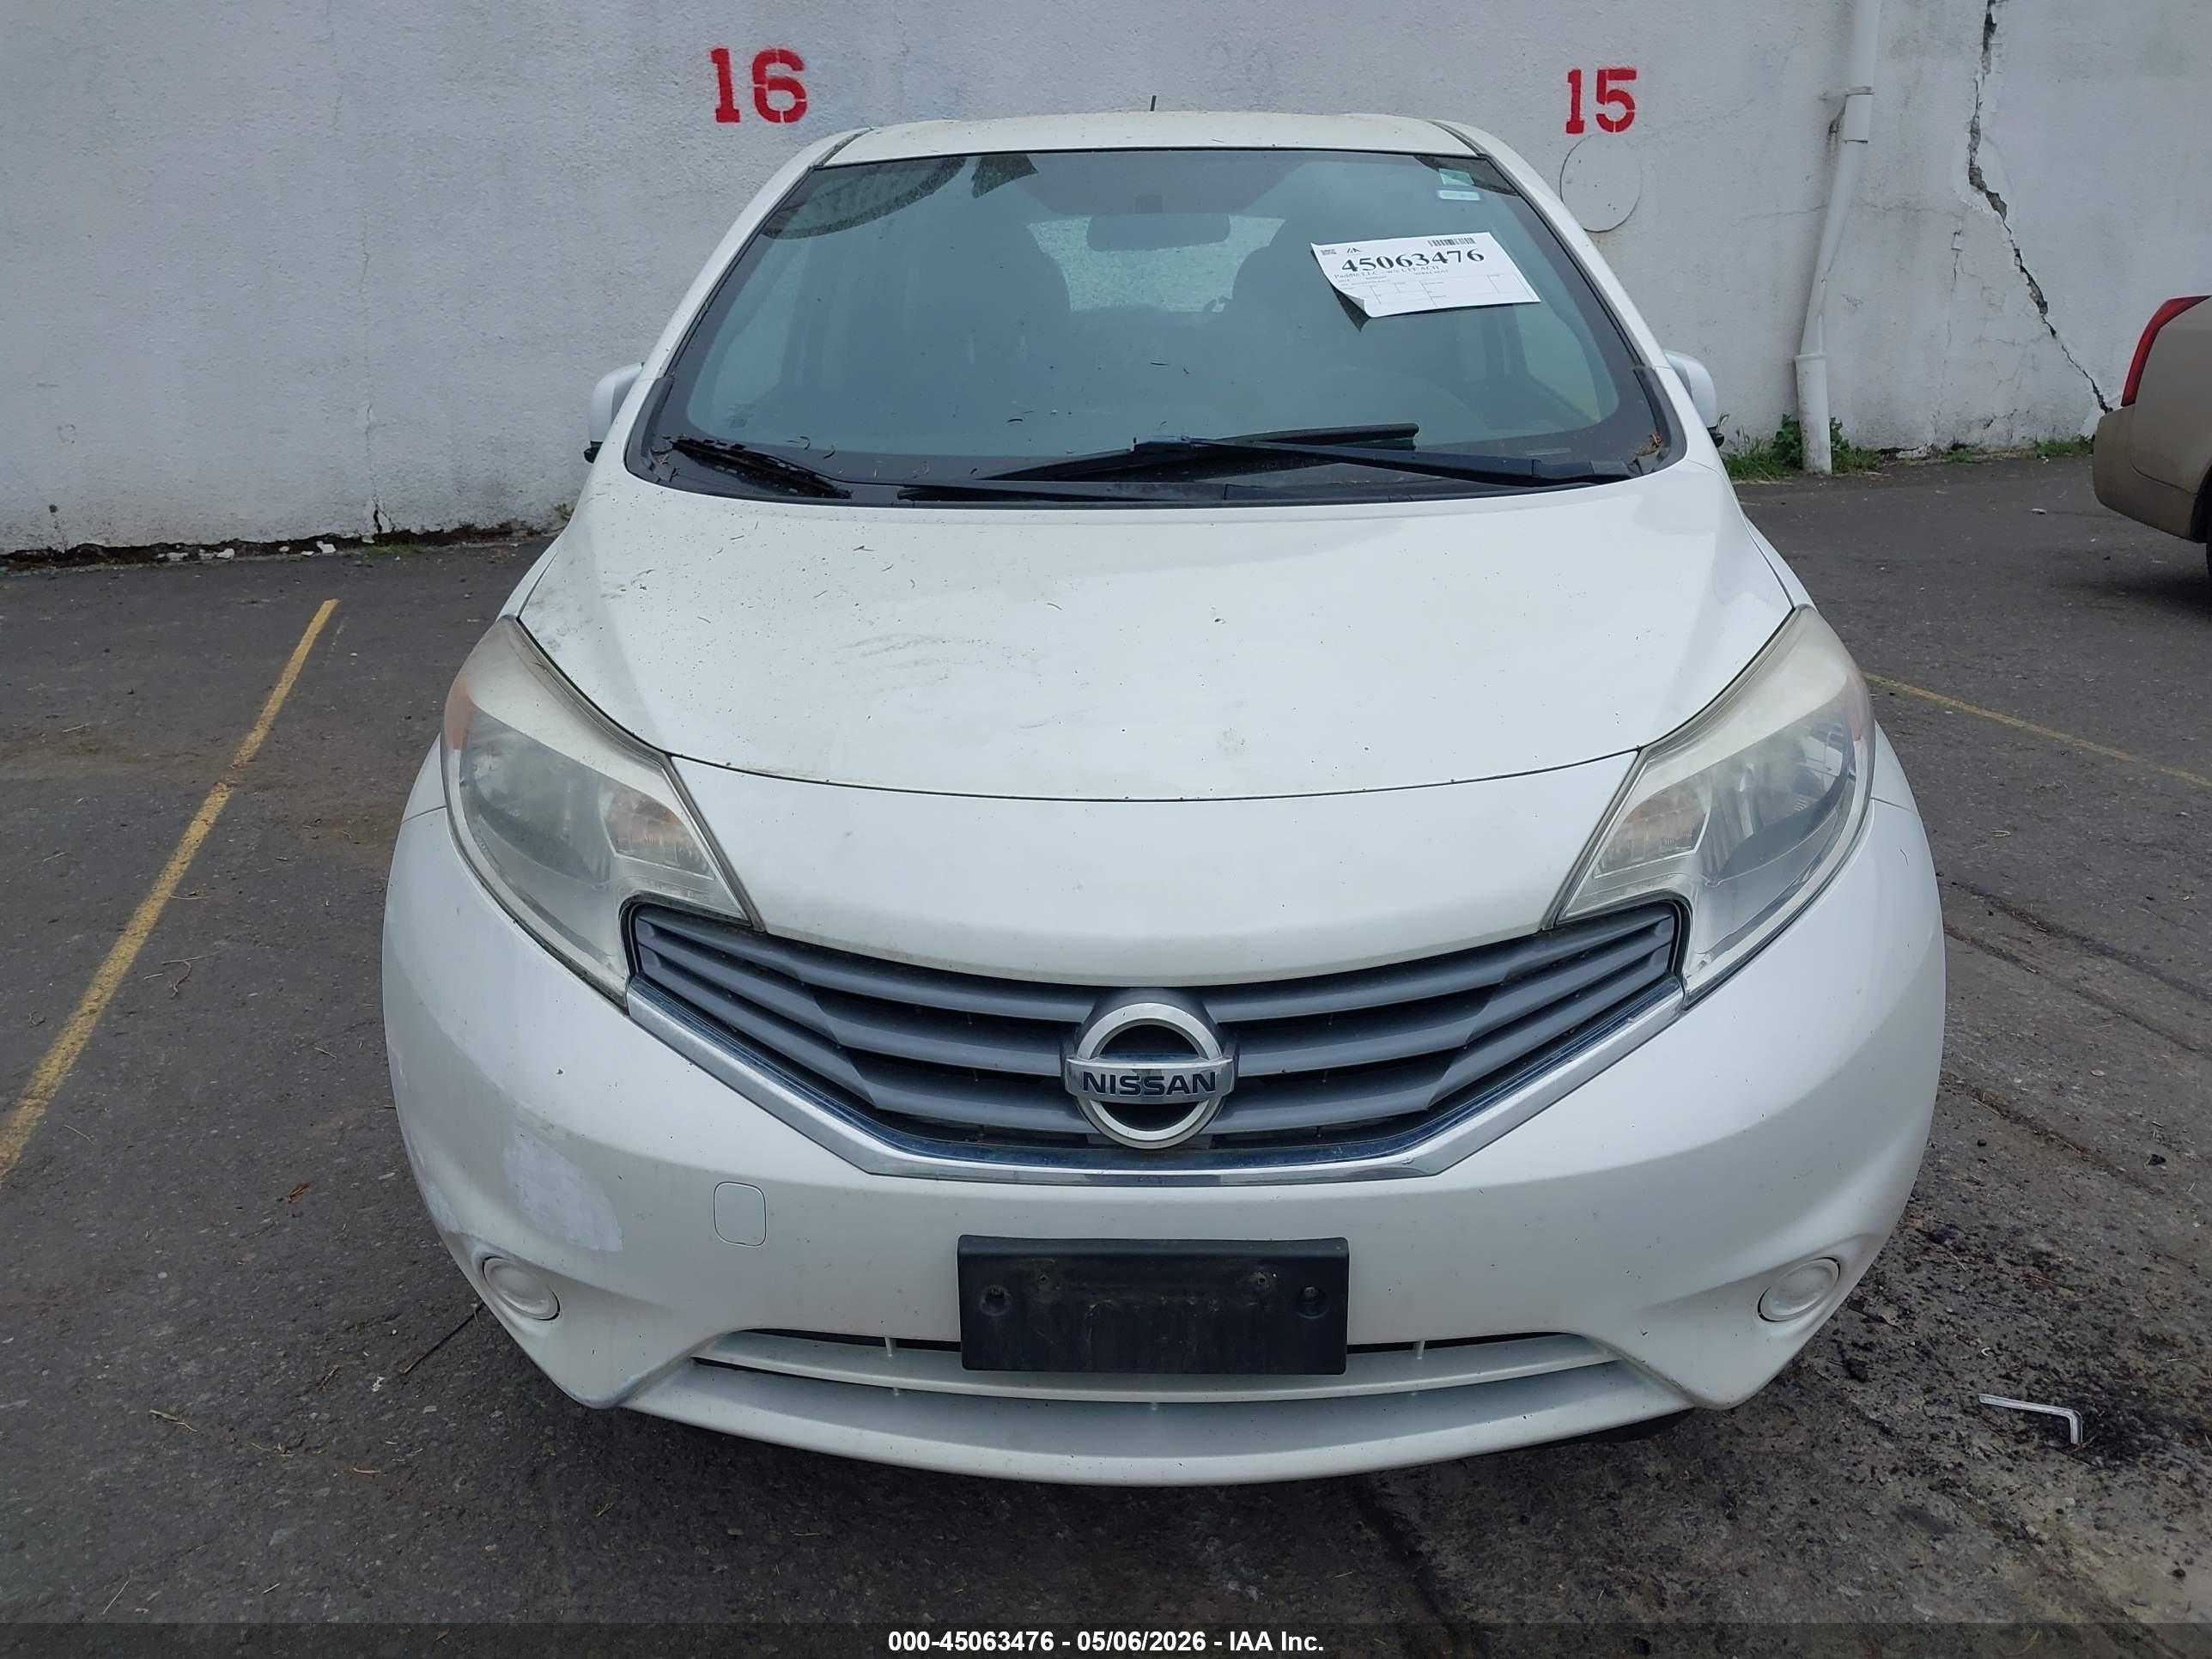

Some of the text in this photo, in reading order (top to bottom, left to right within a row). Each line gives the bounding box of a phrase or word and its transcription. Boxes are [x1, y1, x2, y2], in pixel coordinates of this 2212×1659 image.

[710, 48, 808, 124] 16
[1565, 68, 1638, 134] 15
[1341, 248, 1485, 272] 45063476
[1082, 1071, 1216, 1096] NISSAN
